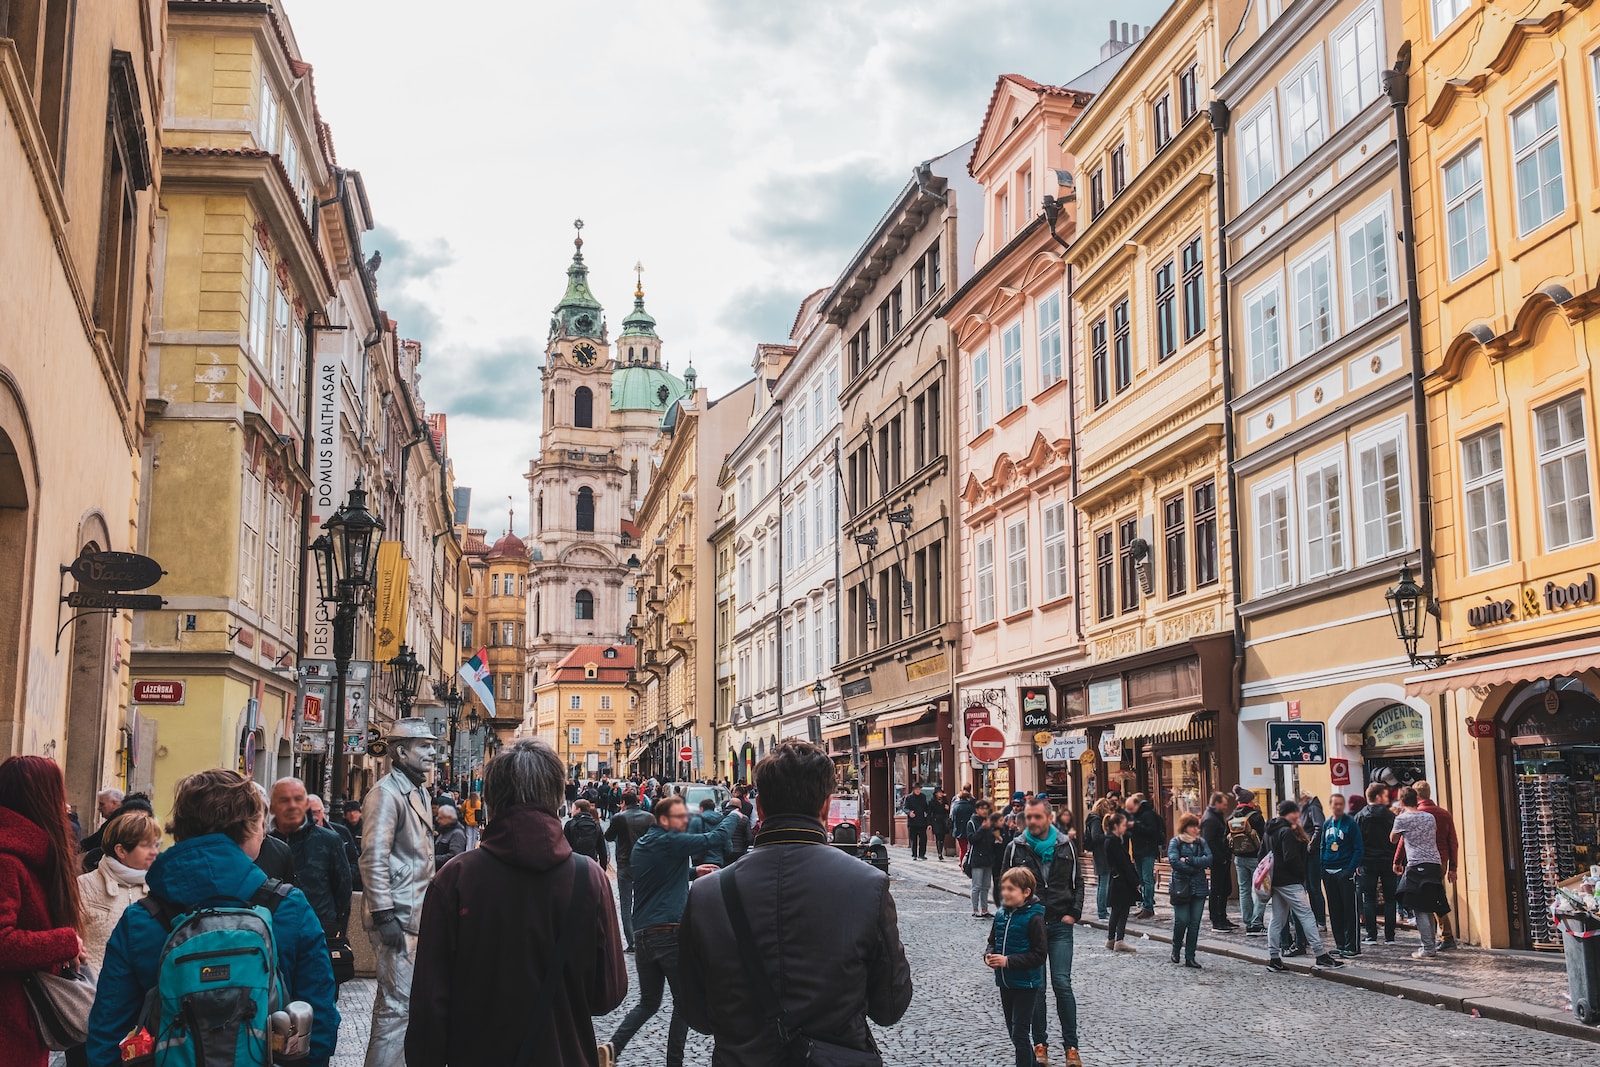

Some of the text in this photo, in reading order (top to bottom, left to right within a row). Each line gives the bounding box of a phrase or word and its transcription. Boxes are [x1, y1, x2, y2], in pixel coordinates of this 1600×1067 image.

[319, 364, 335, 506] DOMUS BALTHASAR
[1467, 572, 1596, 627] wine & food
[1024, 714, 1049, 726] Pork's
[1372, 705, 1415, 734] SOUVENIR
